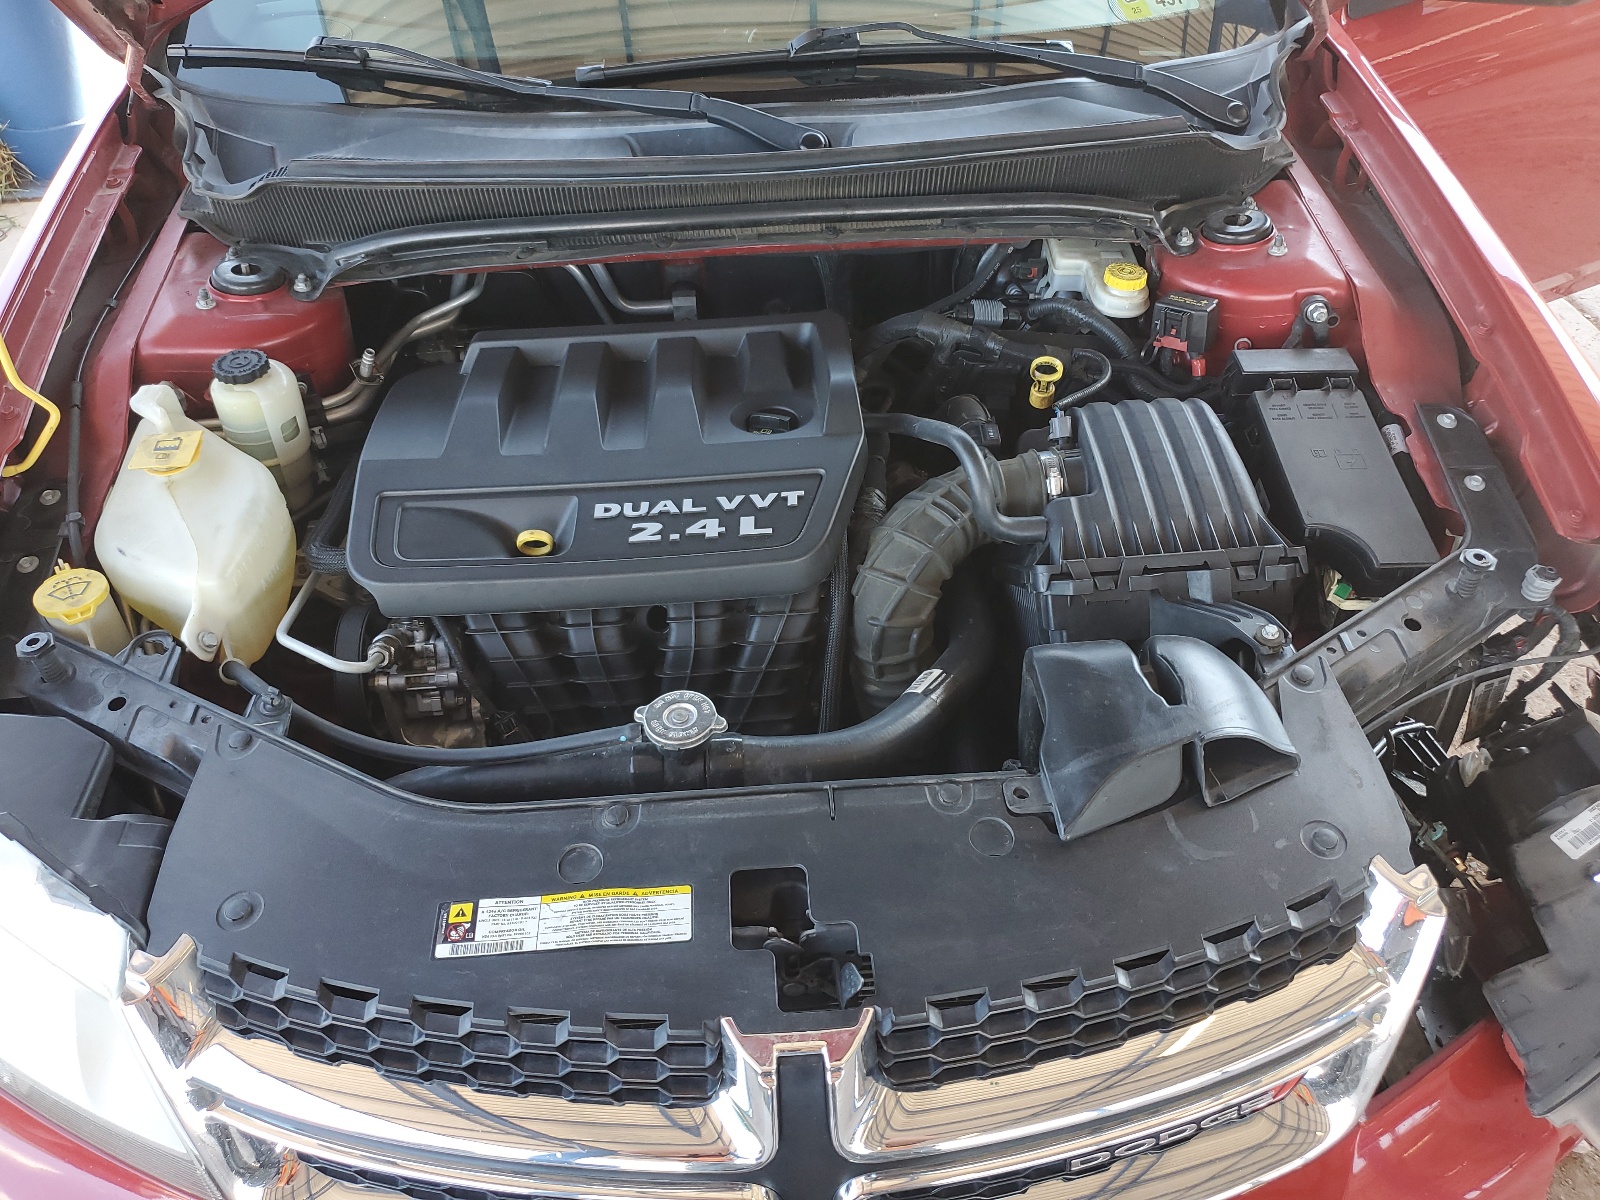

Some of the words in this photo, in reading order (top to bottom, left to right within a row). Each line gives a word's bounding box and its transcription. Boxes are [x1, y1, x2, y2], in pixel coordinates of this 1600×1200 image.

[593, 498, 707, 519] DUAL
[715, 490, 805, 512] VVT
[628, 518, 726, 544] 2.4
[738, 515, 773, 537] L
[550, 894, 577, 902] WARNING
[641, 888, 679, 896] ADVERTENCIA
[1070, 1088, 1275, 1172] DODGE
